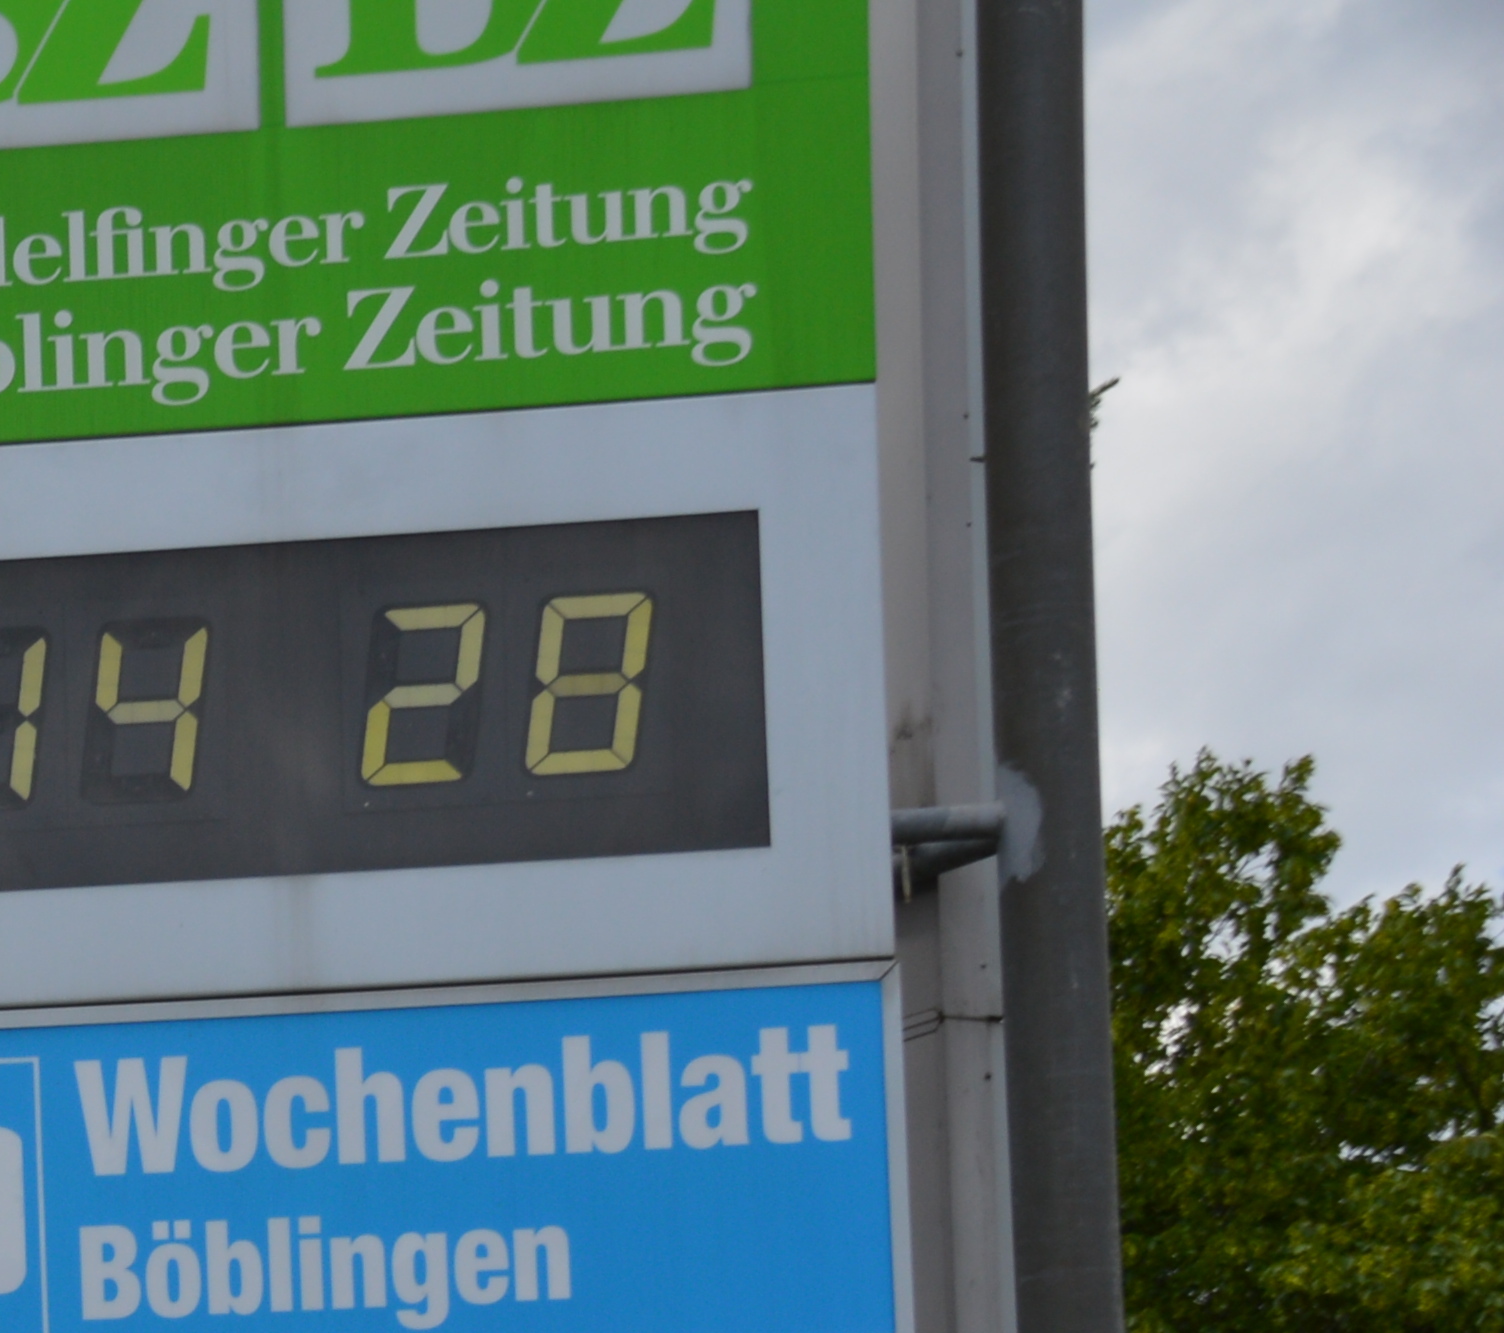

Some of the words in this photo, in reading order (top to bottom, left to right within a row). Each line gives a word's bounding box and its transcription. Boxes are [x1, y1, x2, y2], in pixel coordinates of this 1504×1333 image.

[384, 177, 753, 259] Zeitung
[343, 279, 758, 370] Zeitung
[8, 624, 209, 802] 14
[360, 591, 654, 788] 28
[74, 1023, 852, 1177] Wochenblatt
[79, 1215, 572, 1330] Böblingen
